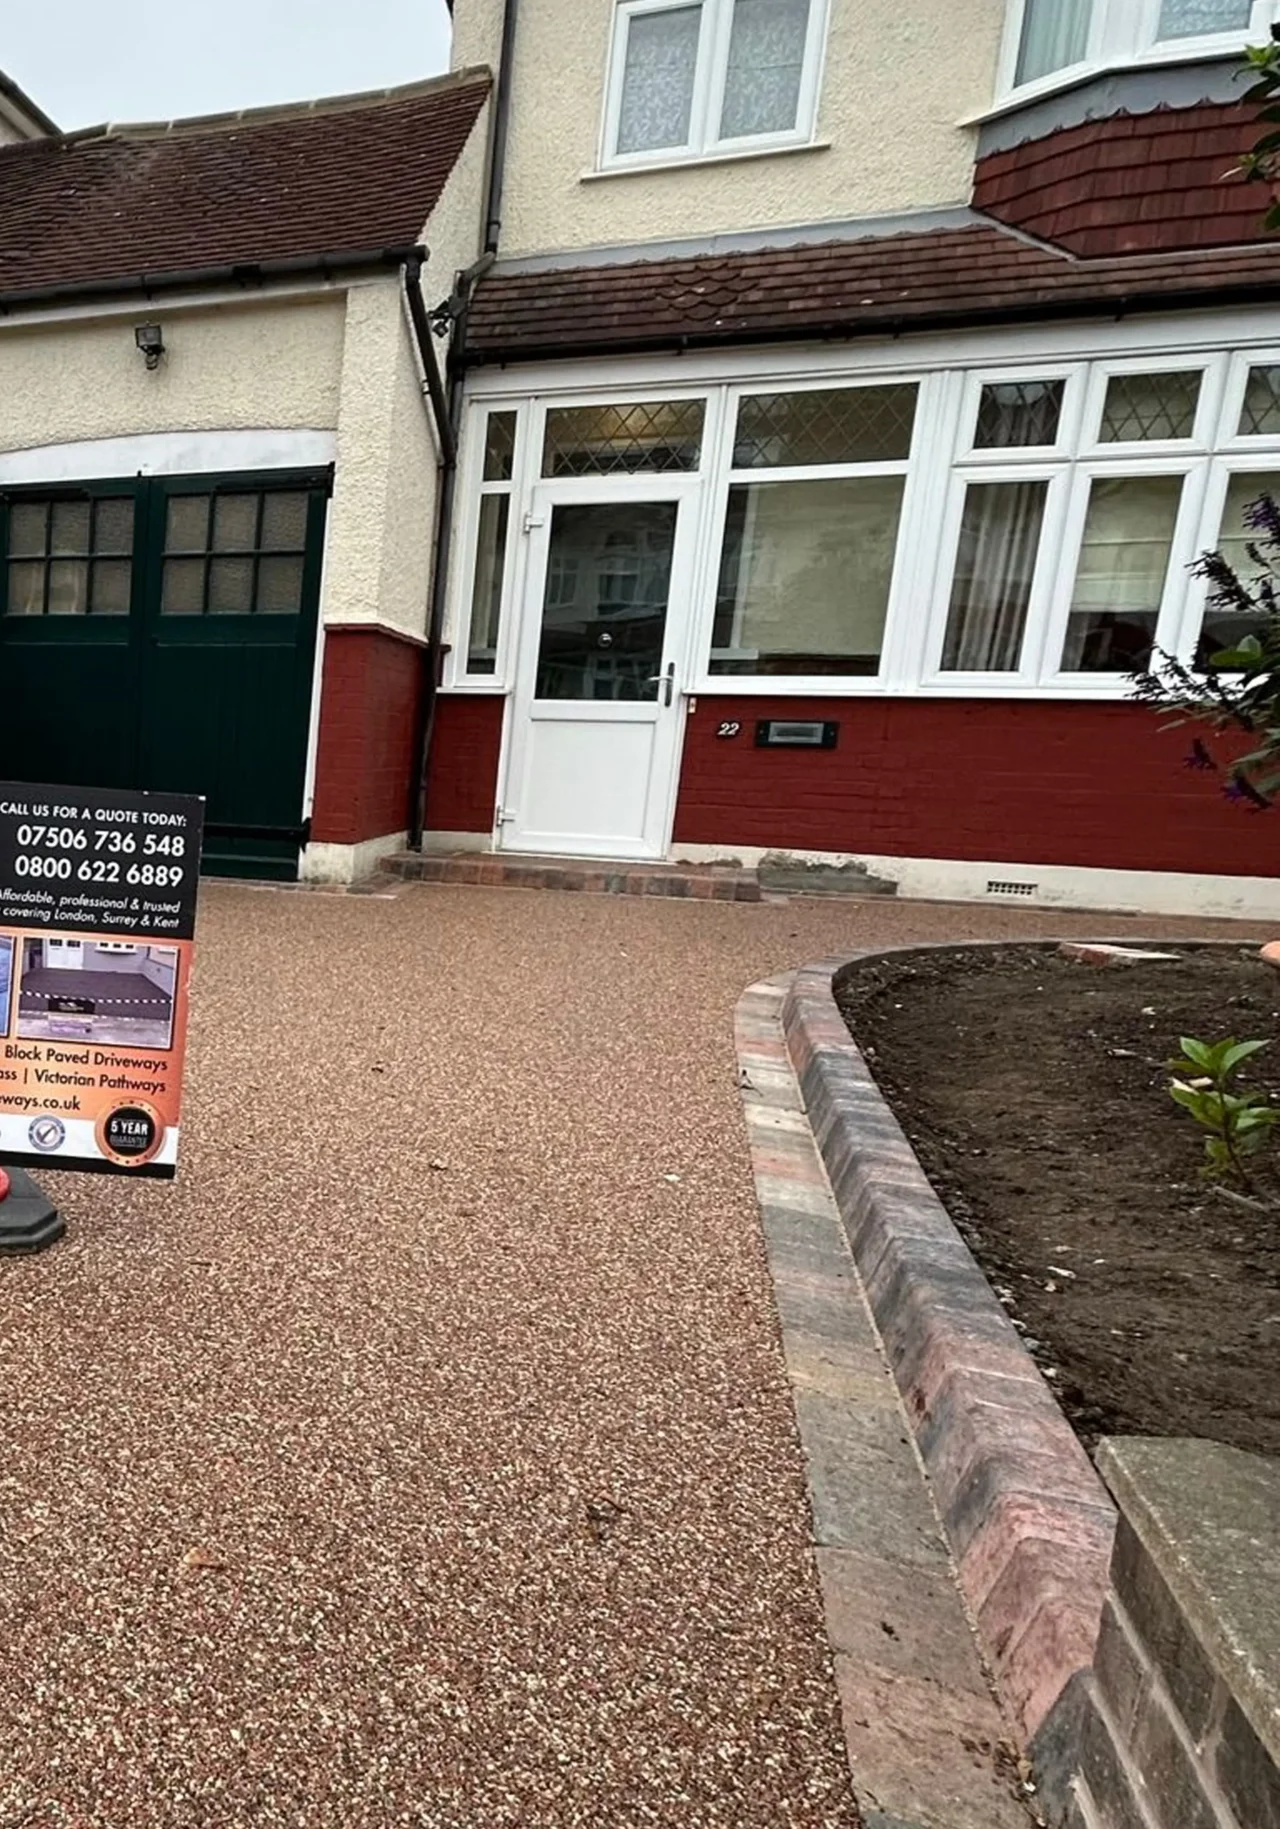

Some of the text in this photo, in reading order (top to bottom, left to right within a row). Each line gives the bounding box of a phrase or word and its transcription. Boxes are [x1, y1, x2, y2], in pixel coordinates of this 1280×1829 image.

[717, 722, 740, 736] 22
[0, 802, 187, 827] CALL US FOR A QUOTE TODAY:
[17, 824, 185, 857] 07506 736 548
[15, 855, 184, 887] 0800 622 6889
[59, 895, 128, 911] professional
[131, 897, 139, 910] &
[143, 899, 181, 913] trusted
[3, 906, 51, 922] covering
[54, 908, 99, 924] London,
[102, 912, 138, 928] Surrey
[140, 914, 150, 927] &
[153, 915, 179, 928] Kent
[5, 1044, 42, 1061] Block
[46, 1050, 89, 1066] Paved
[94, 1053, 168, 1073] Driveways
[34, 1069, 95, 1086] Victorian
[99, 1074, 166, 1095] Pathways
[121, 1121, 148, 1136] YEAR
